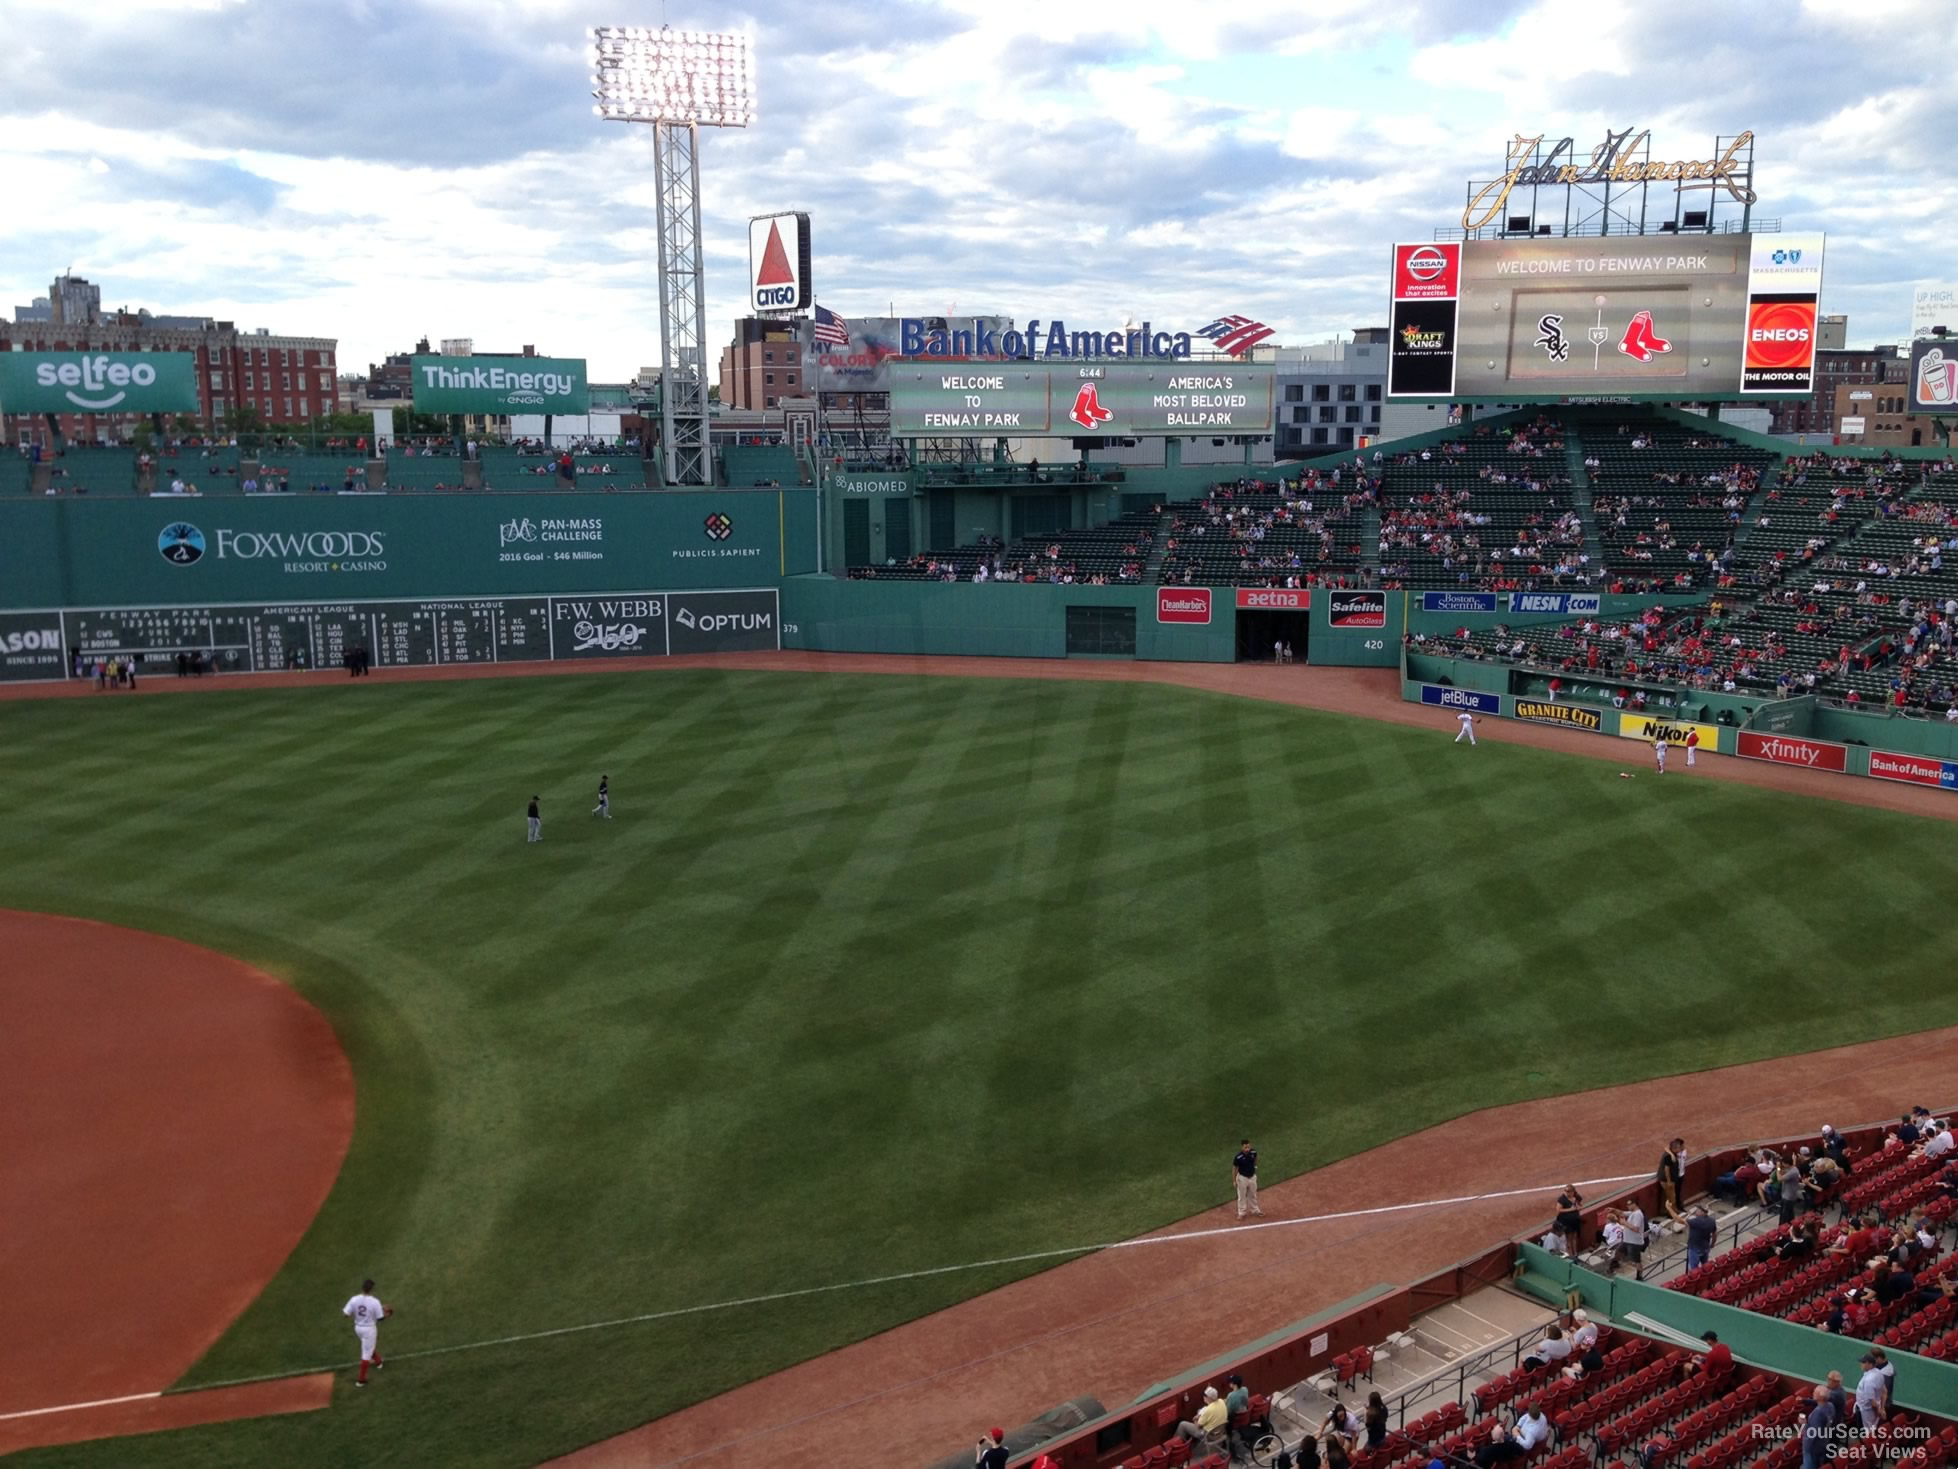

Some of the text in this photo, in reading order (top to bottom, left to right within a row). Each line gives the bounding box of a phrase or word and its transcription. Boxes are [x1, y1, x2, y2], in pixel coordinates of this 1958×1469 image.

[1462, 127, 1757, 230] John Hancock
[1409, 260, 1444, 268] NISSAN
[1496, 256, 1707, 274] WELCOME TO FENWAY PARK
[757, 286, 795, 306] CITGO
[1917, 292, 1929, 302] UP
[1407, 332, 1443, 341] DRAFT
[1593, 331, 1604, 339] VS
[1751, 328, 1809, 342] ENEOS
[1914, 326, 1933, 337] jetBlu
[900, 318, 1191, 358] Bank of America
[1409, 340, 1442, 348] KINGS
[811, 342, 832, 354] MY
[1078, 367, 1101, 378] 6:44
[1744, 372, 1811, 381] THE MOTOR OIL
[422, 365, 573, 395] ThinkEnergy
[941, 376, 1004, 390] WELCOME
[1168, 376, 1233, 390] AMERICA'S
[964, 395, 981, 408] TO
[1153, 394, 1246, 408] MOST BELOVED
[924, 413, 1020, 427] FENWAY PARK
[1166, 412, 1232, 426] BALLPARK
[847, 481, 907, 493] ABIOMED
[541, 519, 602, 530] PAN-MASS
[541, 530, 603, 541] CHALLENGE
[215, 529, 384, 559] FOXWOODS
[499, 552, 521, 561] 2016
[523, 552, 544, 561] Goal
[554, 551, 570, 561] $46
[572, 551, 603, 560] Million
[284, 561, 387, 573] RESORT CASINO
[1247, 591, 1299, 606] aetna
[1445, 594, 1475, 603] Boston
[1520, 595, 1562, 611] NESN
[264, 605, 355, 614] AMERICAN LEAGUE
[556, 600, 663, 620] F.W. WEBB
[1331, 601, 1384, 613] Safelite
[1438, 600, 1486, 610] Scientific
[172, 609, 210, 618] PARK
[700, 613, 771, 632] OPTUM
[1345, 617, 1383, 626] AutoGlass
[138, 628, 170, 637] JUNE
[783, 624, 798, 634] 379
[150, 637, 181, 647] 2016
[594, 623, 639, 650] 150
[90, 640, 120, 648] BOSTON
[1364, 640, 1384, 650] 420
[1440, 689, 1479, 707] jetBlue
[1517, 702, 1599, 729] GRANITE CITY
[1760, 739, 1820, 765] xfinity
[1872, 758, 1955, 781] Bank of America
[358, 1305, 367, 1316] 2
